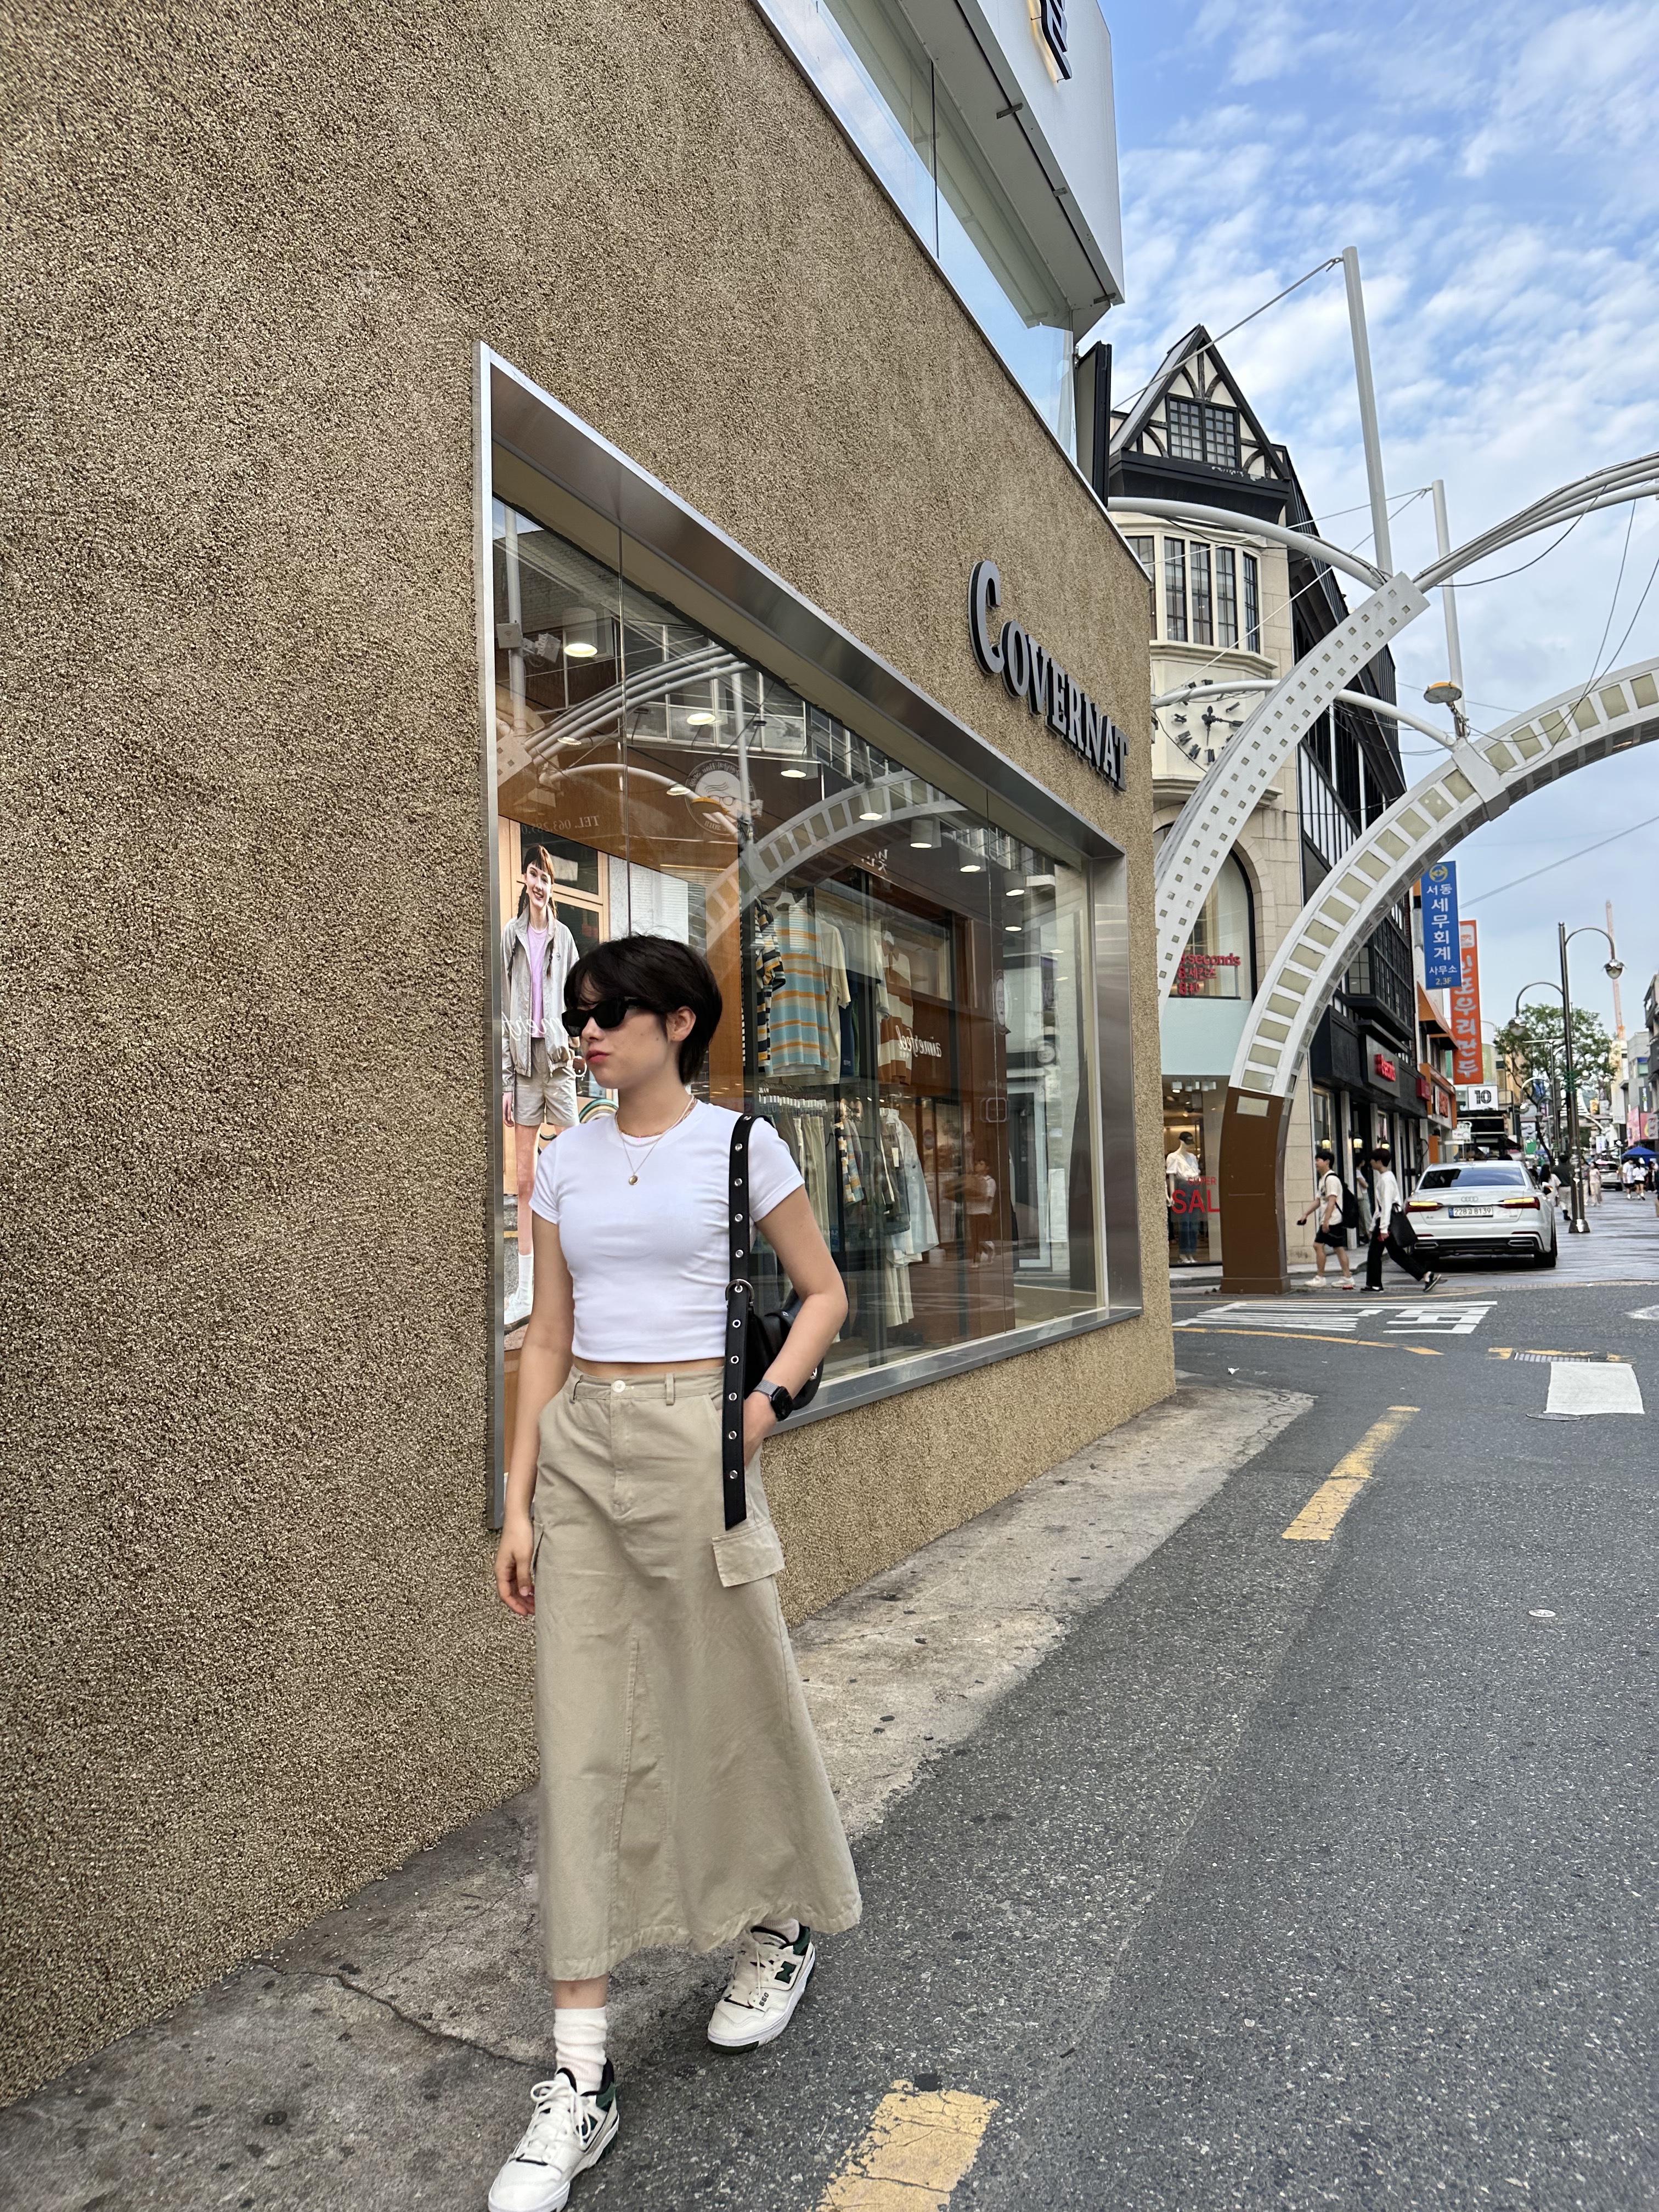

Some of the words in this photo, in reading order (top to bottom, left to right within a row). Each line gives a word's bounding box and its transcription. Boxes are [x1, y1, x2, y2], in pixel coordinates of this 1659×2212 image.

[968, 560, 1130, 792] COVERNAT
[1426, 884, 1452, 896] 서동
[1431, 898, 1451, 961] 세무회계
[1429, 964, 1458, 975] 사무소
[1474, 1090, 1492, 1104] 10
[1172, 1189, 1220, 1214] SAL
[759, 1992, 769, 2007] 550
